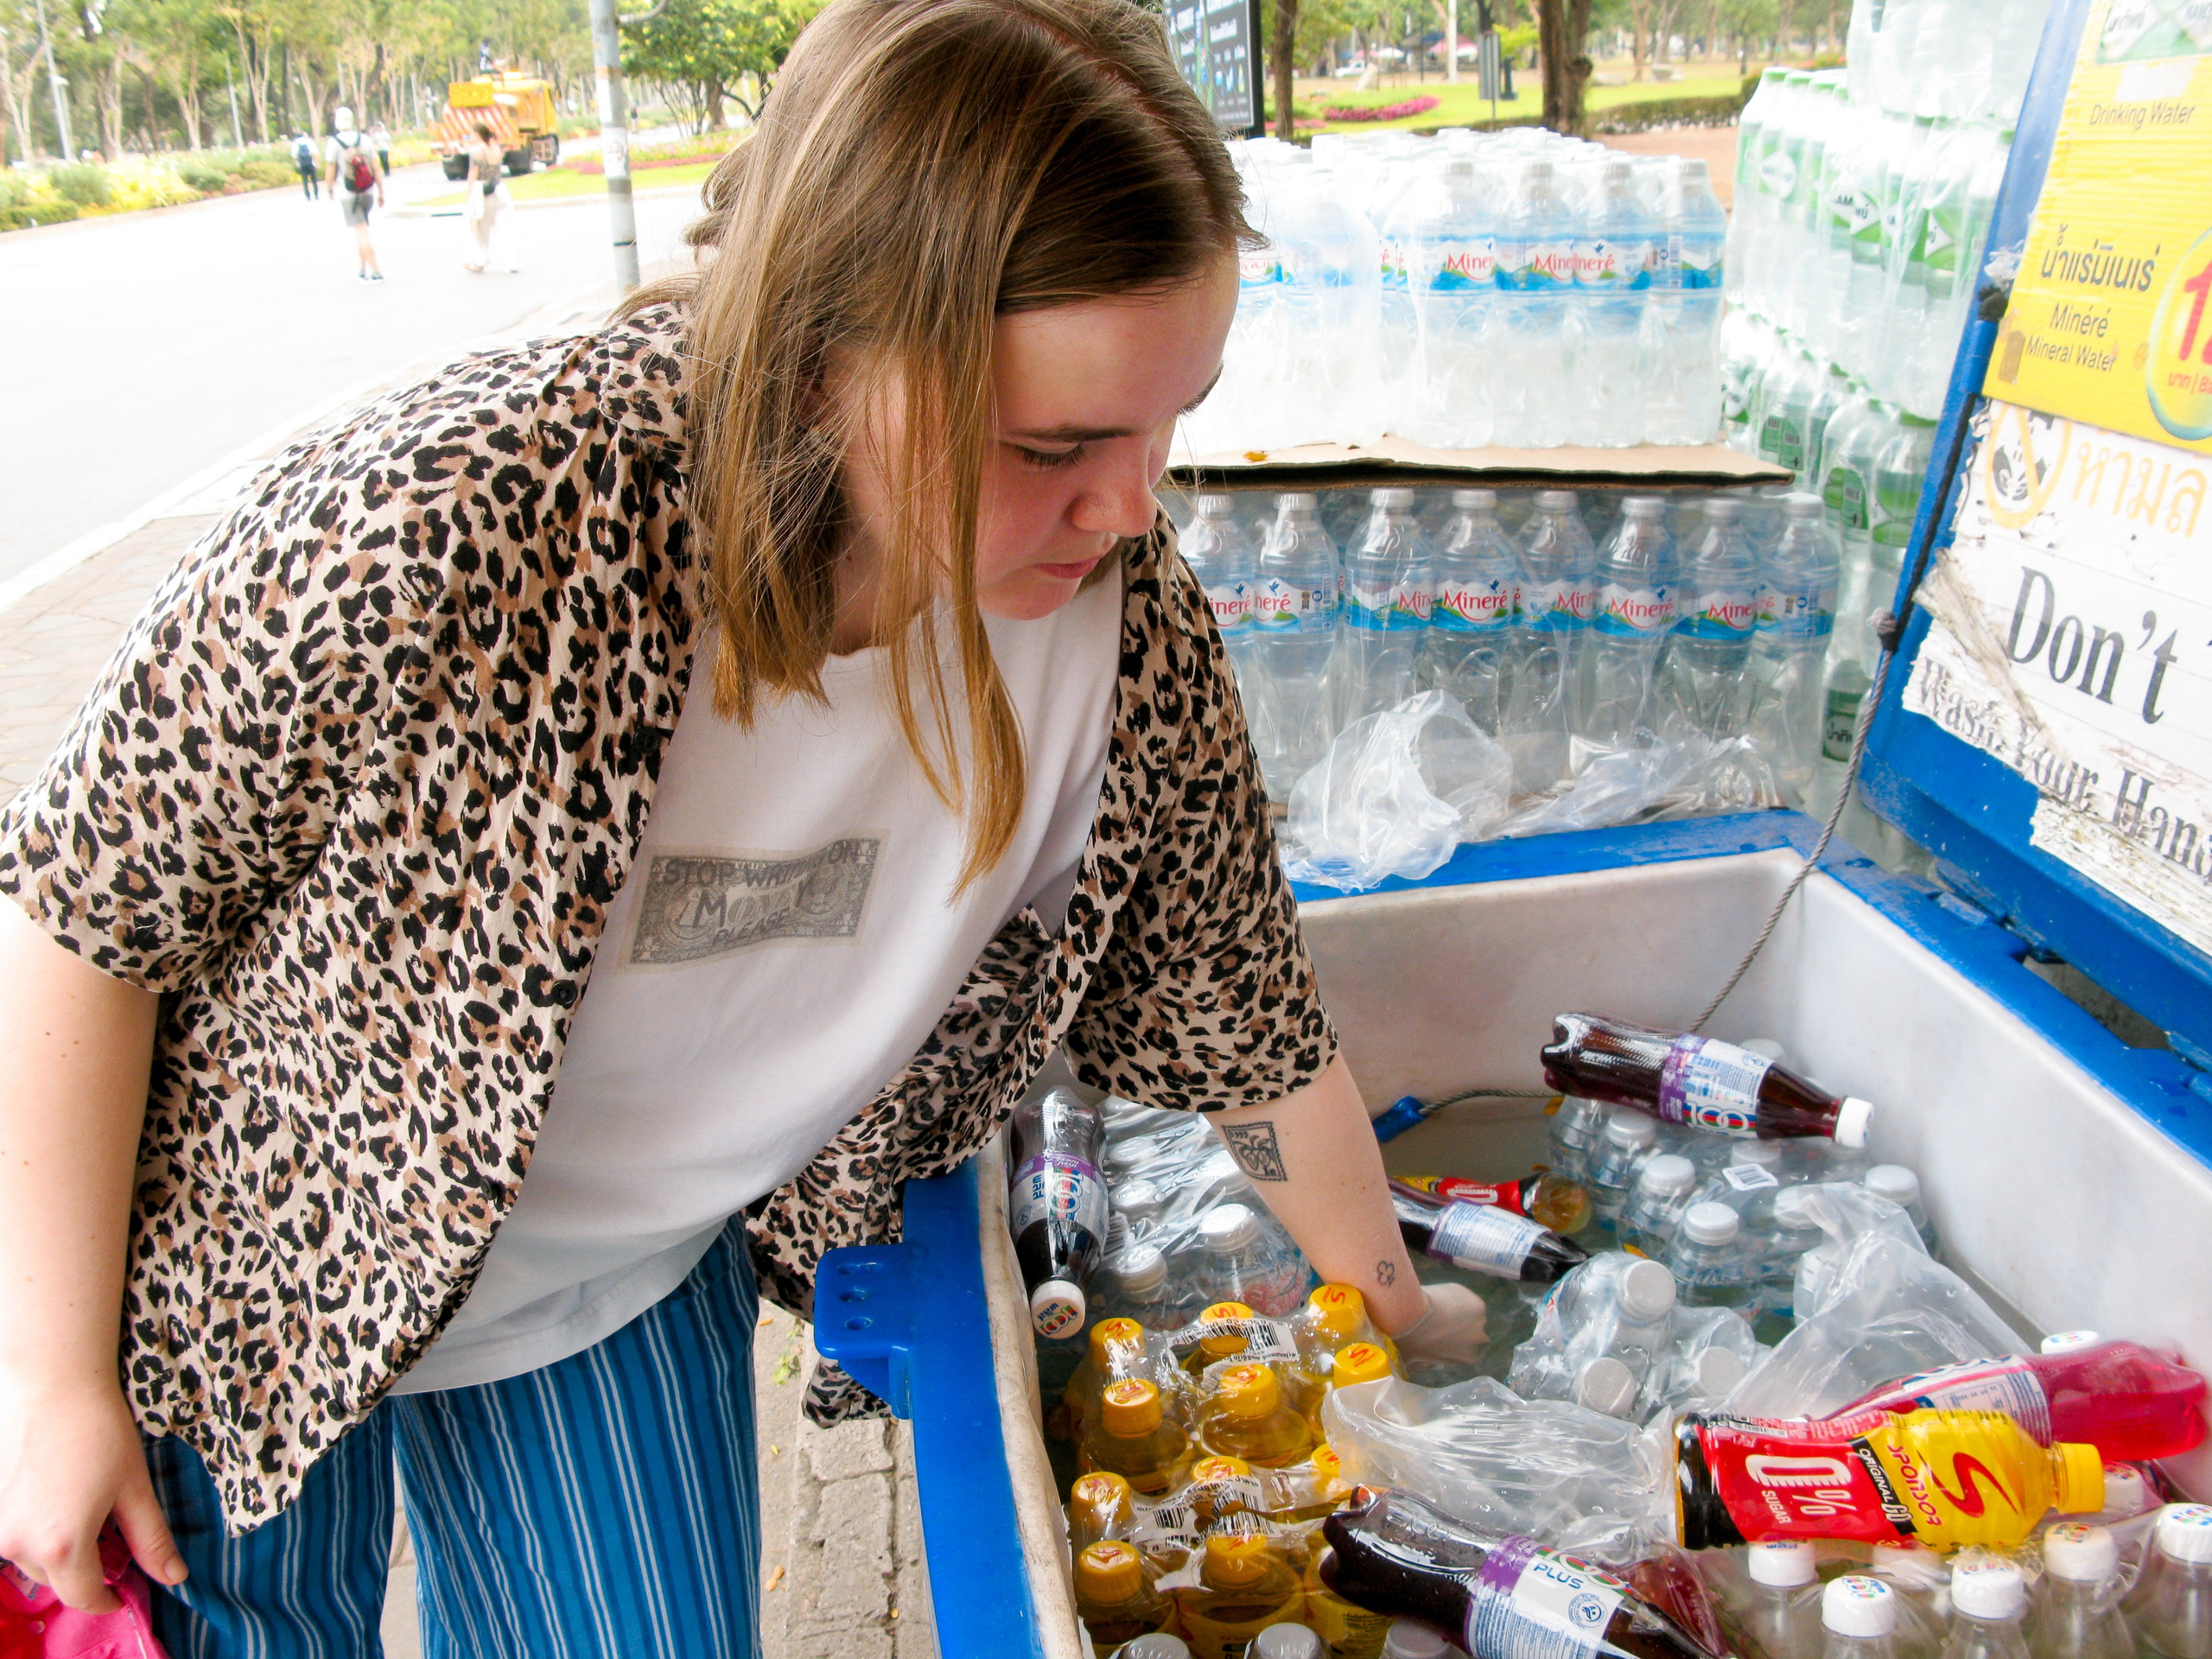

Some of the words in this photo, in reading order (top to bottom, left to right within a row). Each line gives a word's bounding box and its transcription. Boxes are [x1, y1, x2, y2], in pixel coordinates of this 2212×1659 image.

[2090, 104, 2147, 130] Drinking
[2149, 102, 2196, 124] Water
[2050, 302, 2112, 339] Minéré
[2179, 259, 2212, 364] 1
[2025, 334, 2075, 363] Mineral
[2076, 344, 2117, 372] Water
[1442, 589, 1509, 615] Mineré
[1609, 595, 1675, 623] Mineré
[1707, 600, 1757, 624] Mine
[662, 857, 736, 887] STOP
[828, 839, 860, 864] ON
[714, 907, 792, 947] PLEASE
[1688, 1100, 1750, 1132] 100
[1042, 1306, 1078, 1334] 100
[1745, 1454, 1858, 1516] 0%
[1858, 1447, 1895, 1504] ORIGINAL
[1881, 1503, 1913, 1522] GO
[1886, 1444, 1943, 1527] SPONSOR
[1761, 1489, 1792, 1525] SUGAR
[1533, 1562, 1584, 1590] PLUS
